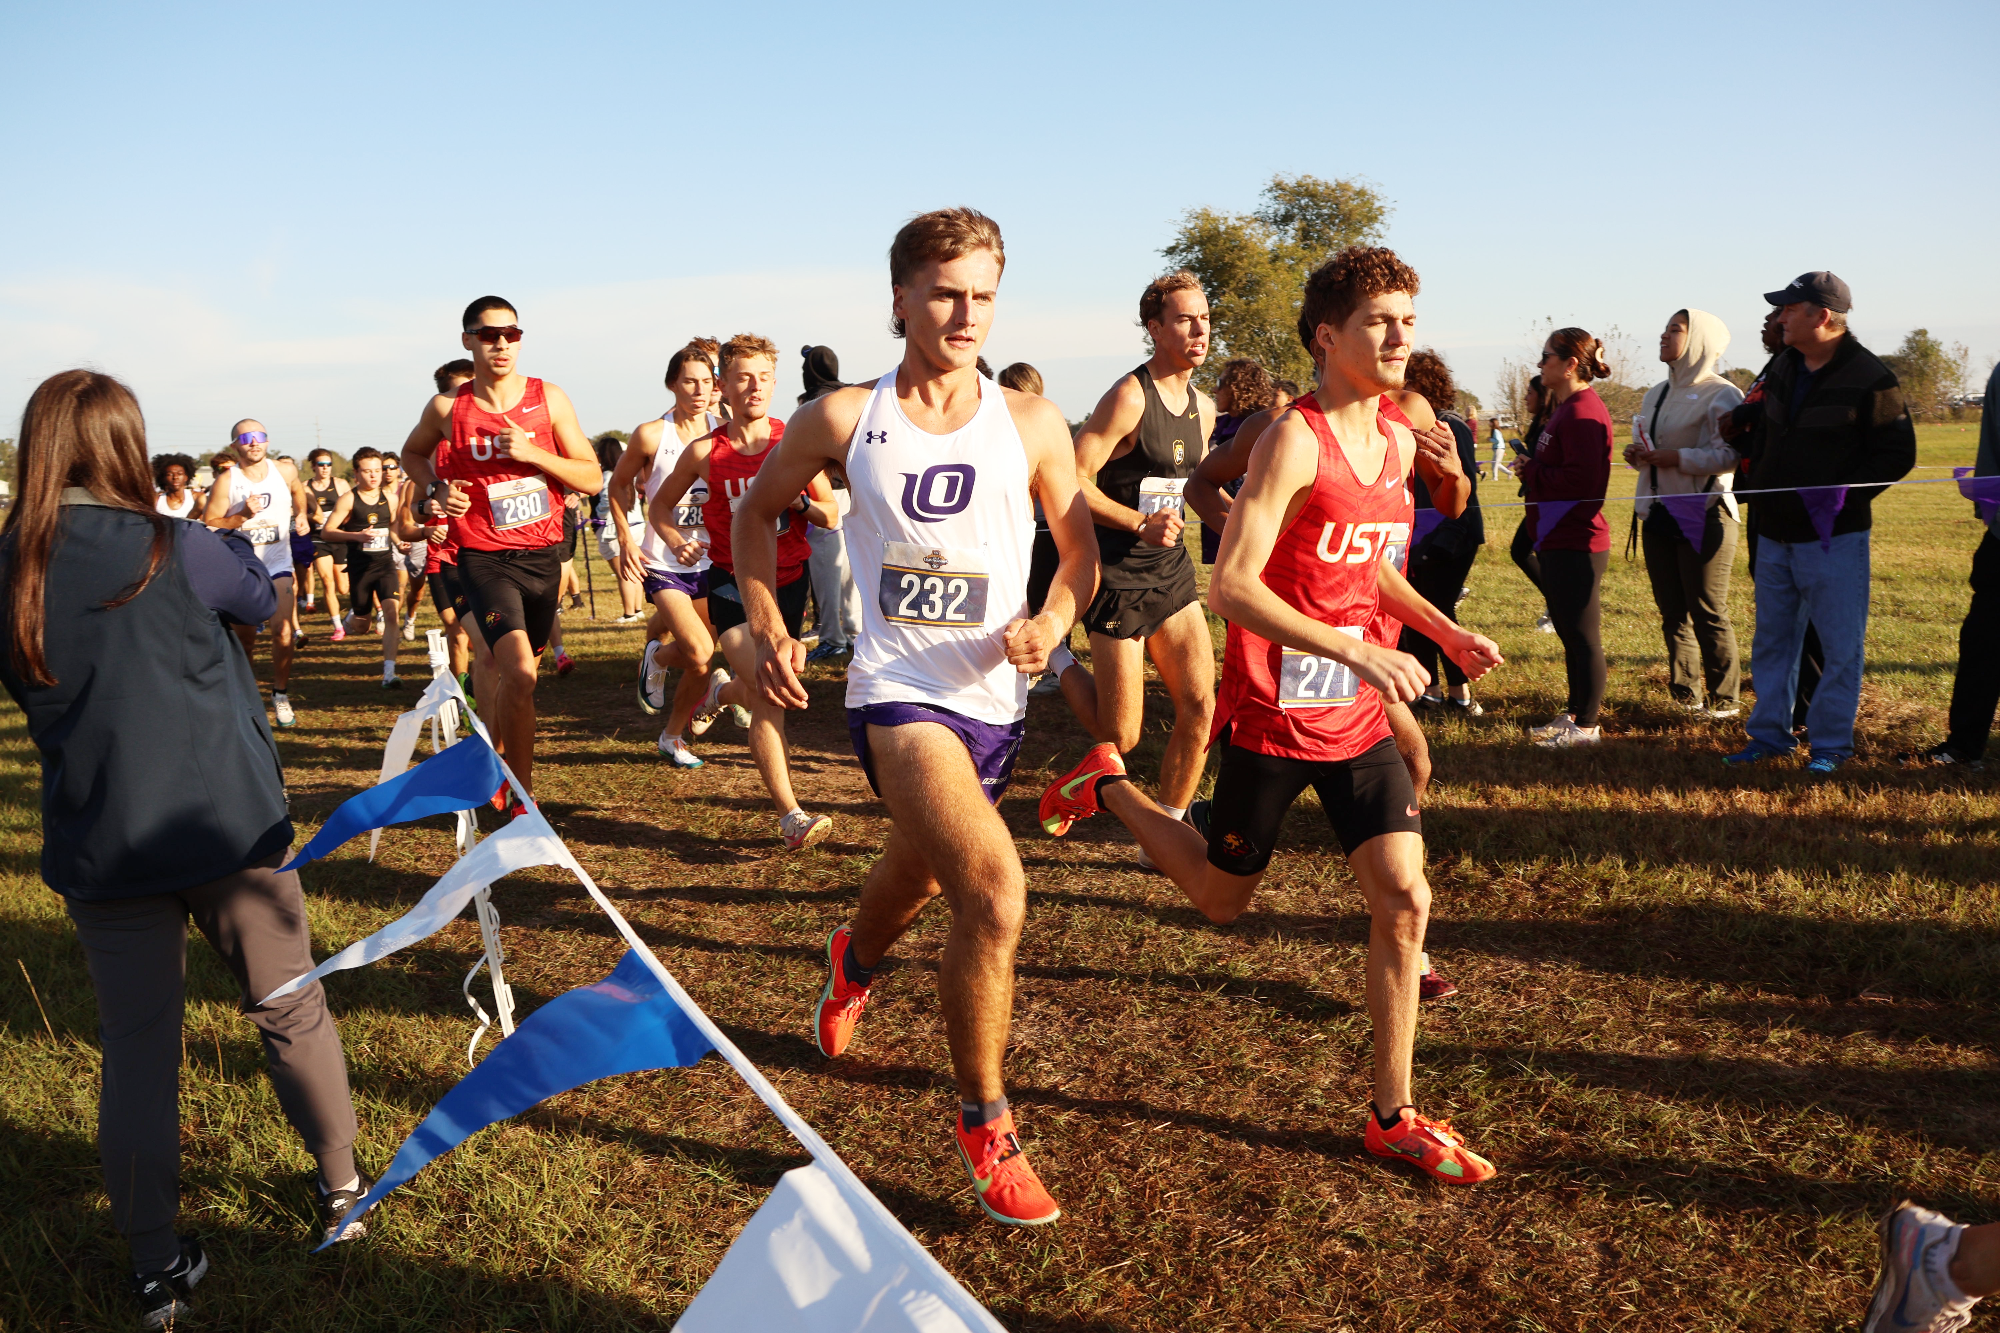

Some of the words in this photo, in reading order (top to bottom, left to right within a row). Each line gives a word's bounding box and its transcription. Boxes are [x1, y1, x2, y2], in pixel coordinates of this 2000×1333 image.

[502, 492, 541, 523] 280
[250, 527, 276, 544] 235
[1316, 521, 1393, 564] UST
[898, 573, 969, 621] 232
[1297, 656, 1350, 698] 271
